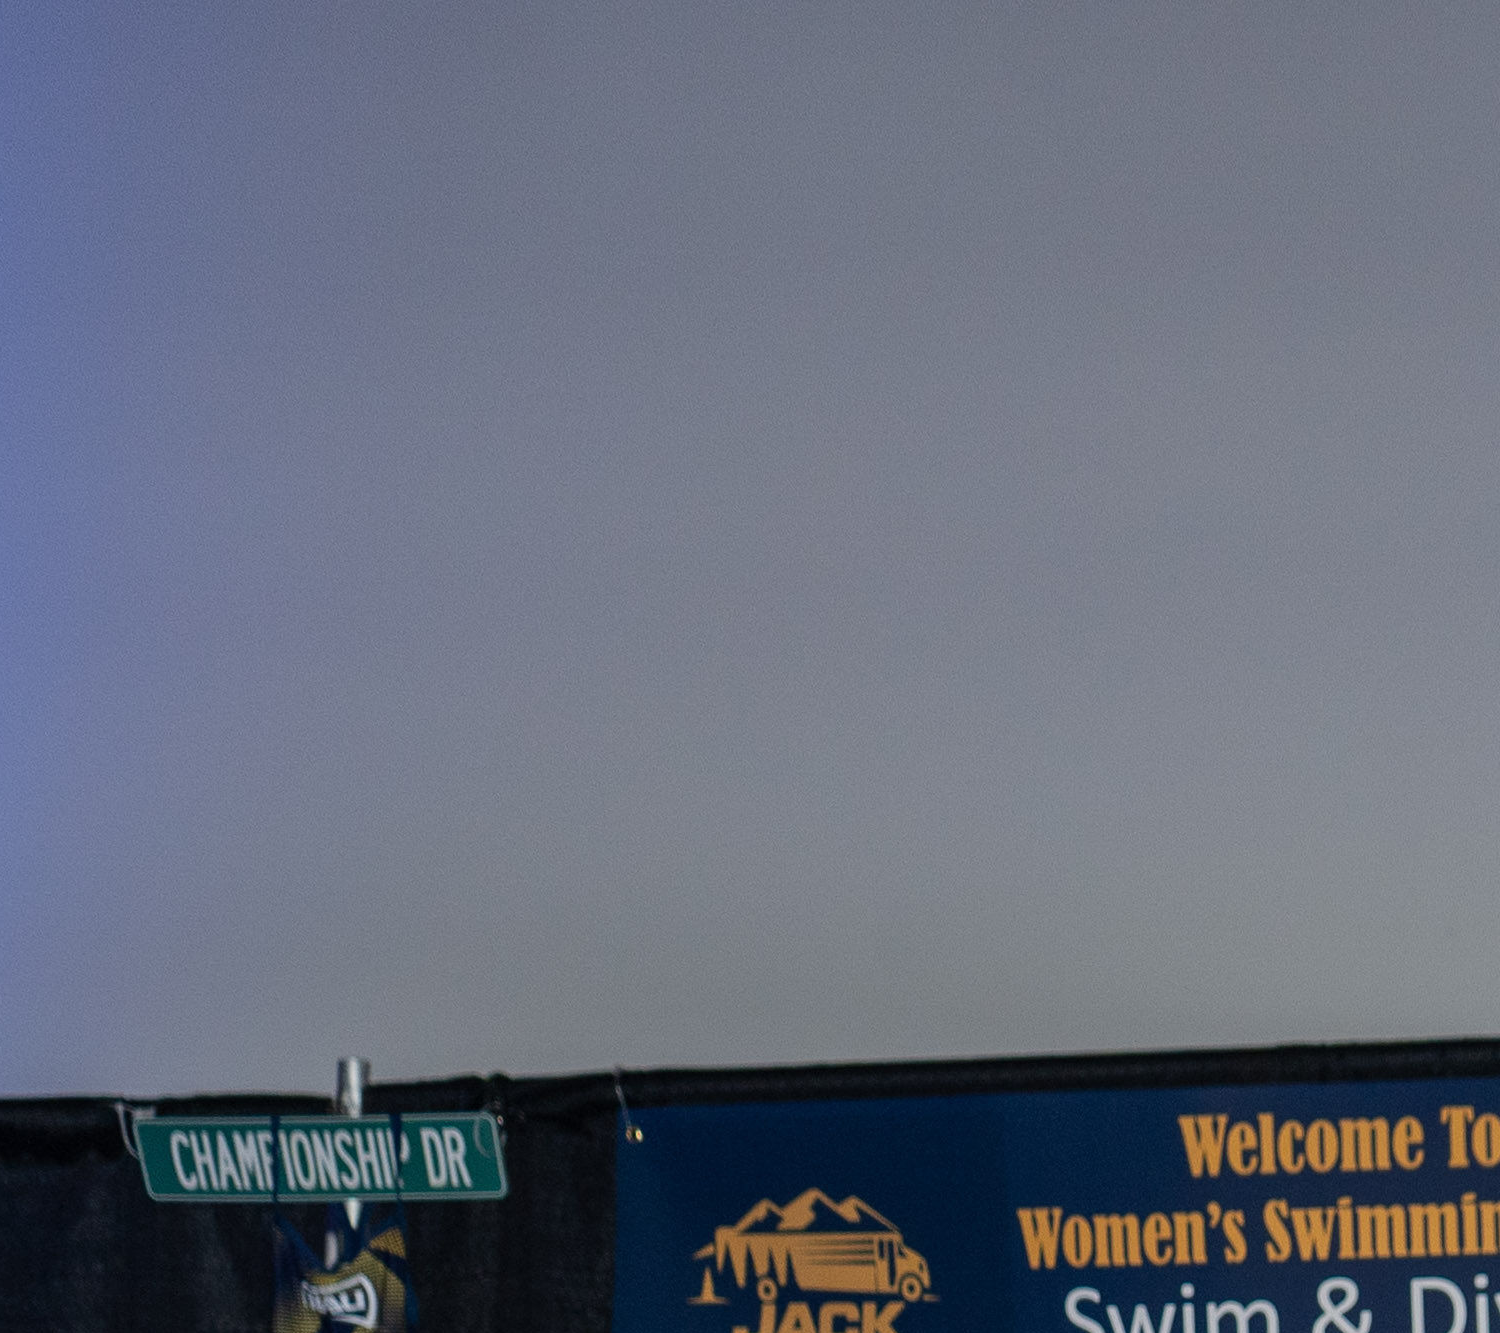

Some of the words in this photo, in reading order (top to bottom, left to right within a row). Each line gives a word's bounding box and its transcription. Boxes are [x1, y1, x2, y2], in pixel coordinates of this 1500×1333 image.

[420, 1126, 473, 1189] DR
[1180, 1112, 1424, 1178] Welcome
[1019, 1205, 1249, 1270] Women's
